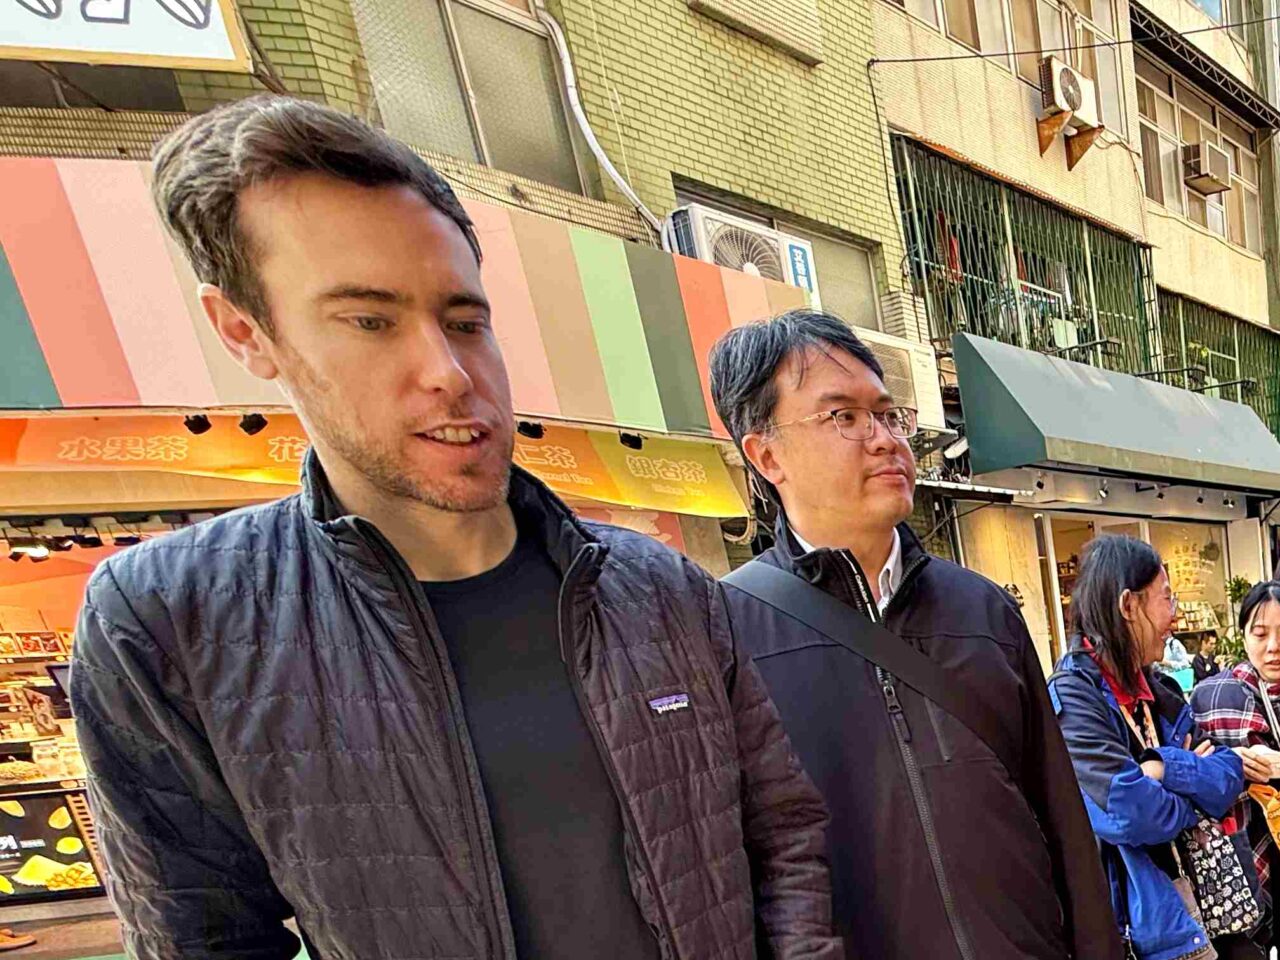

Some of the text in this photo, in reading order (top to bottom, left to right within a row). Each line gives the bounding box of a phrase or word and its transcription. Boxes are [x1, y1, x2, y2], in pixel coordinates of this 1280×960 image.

[57, 435, 188, 462] 水果茶
[268, 436, 306, 462] 花
[515, 444, 577, 468] 仁茶
[626, 454, 707, 484] 銀杏茶
